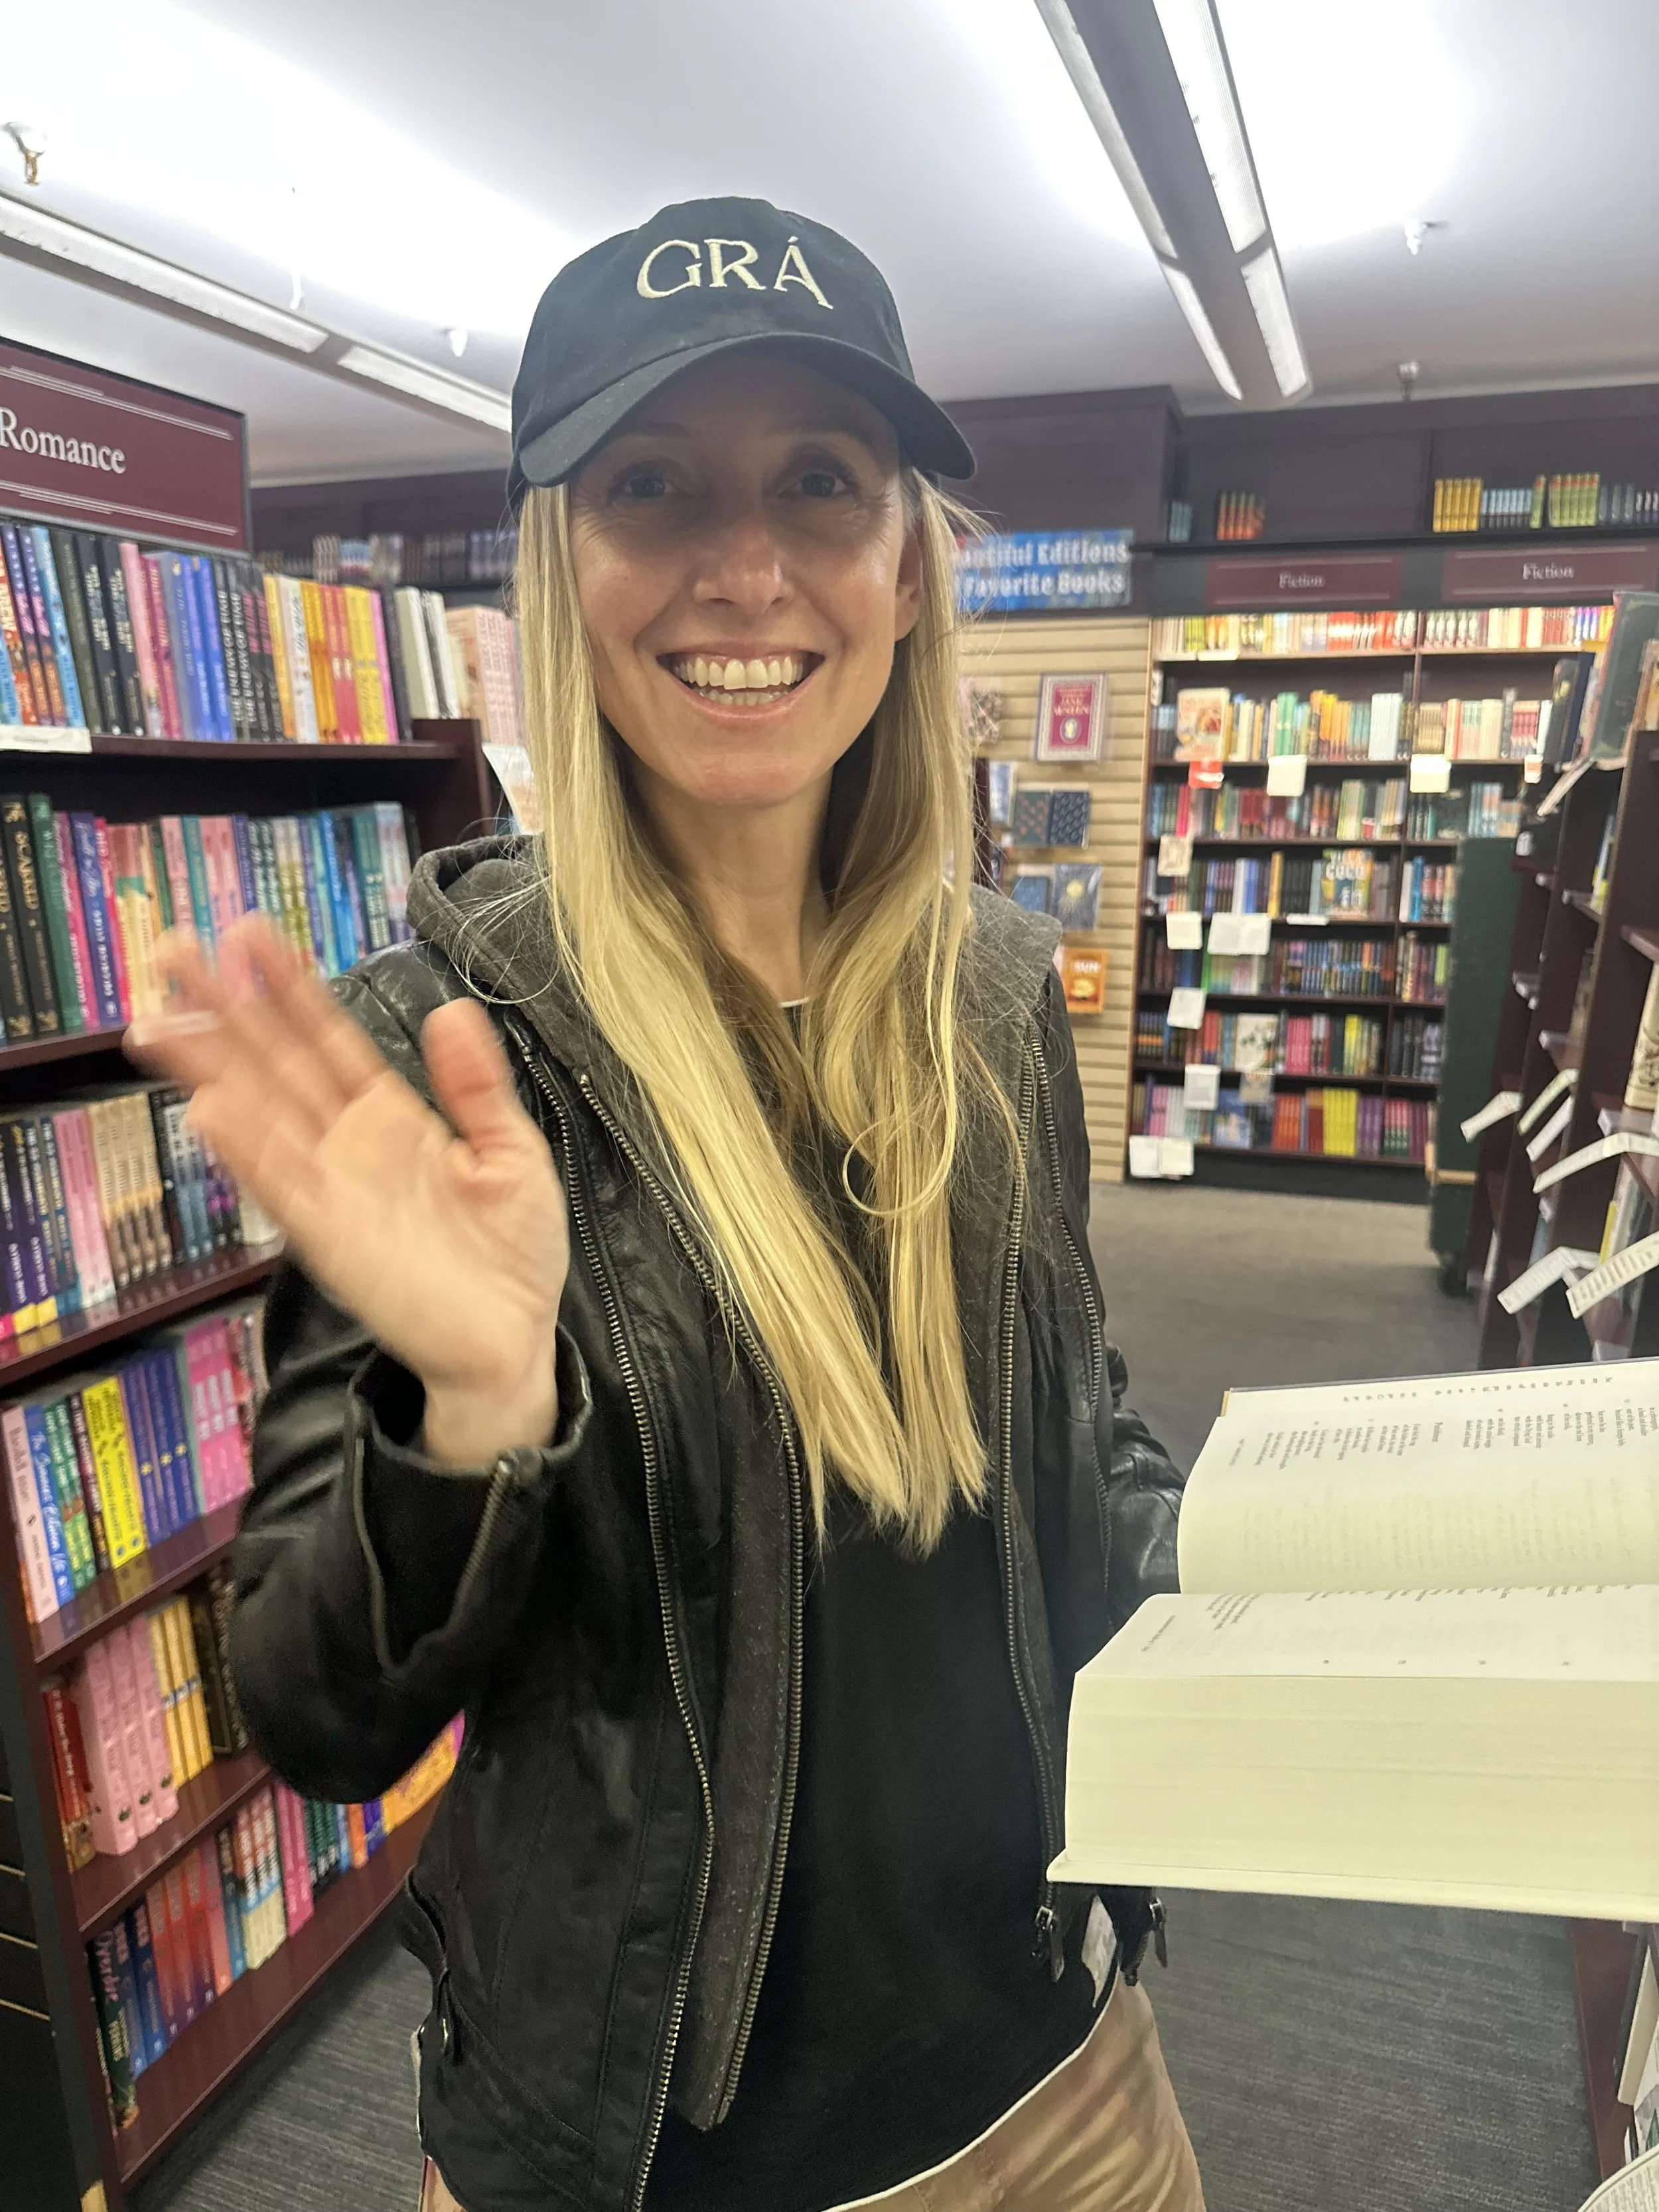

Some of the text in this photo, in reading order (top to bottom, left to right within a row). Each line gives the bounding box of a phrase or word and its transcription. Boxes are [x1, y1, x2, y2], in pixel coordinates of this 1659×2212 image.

[0, 406, 126, 474] Romance
[1037, 537, 1128, 565] Editions
[1057, 569, 1126, 595] Books
[1279, 573, 1325, 590] Fiction
[1522, 563, 1574, 579] Fiction
